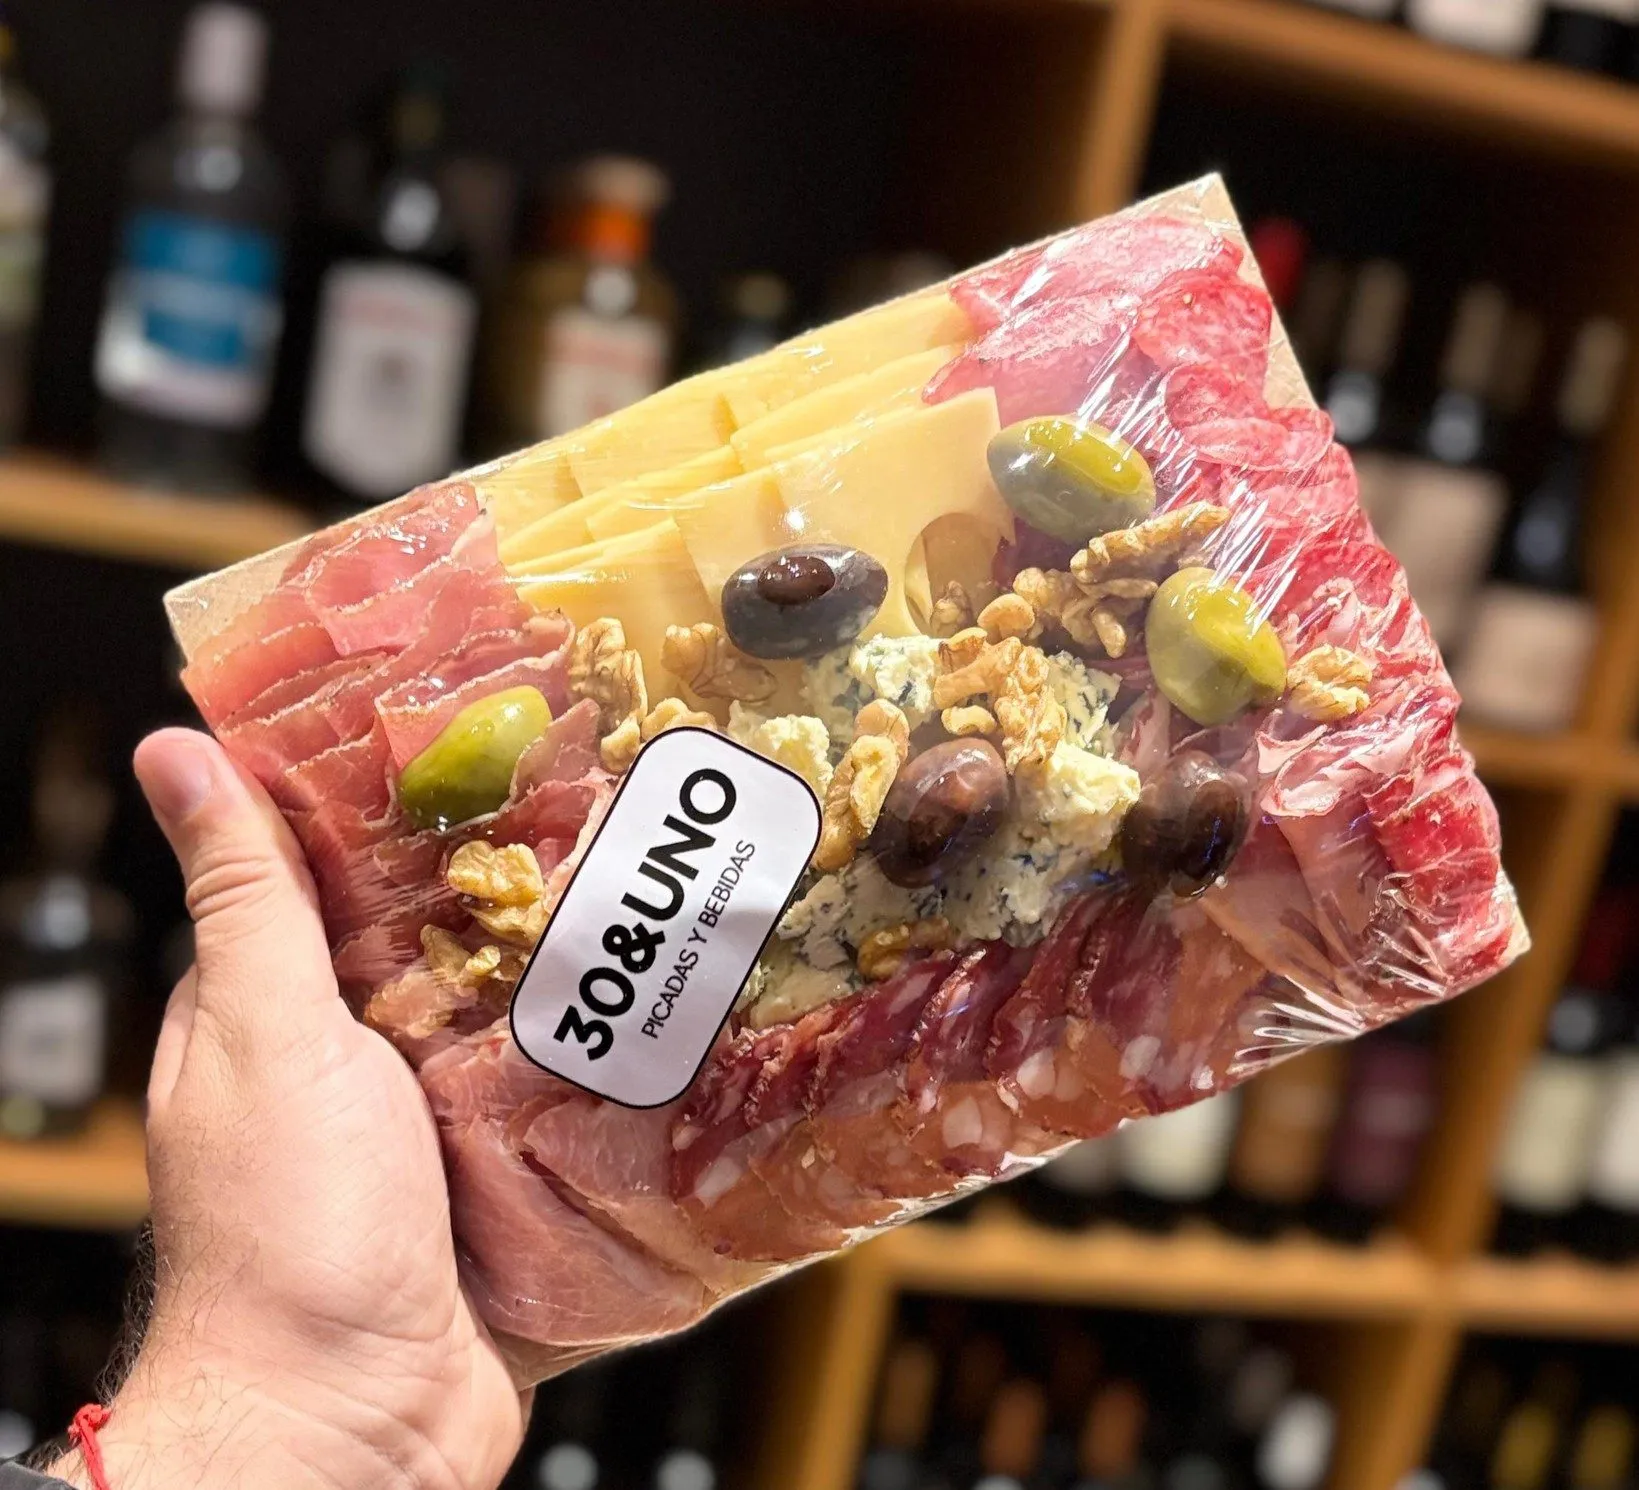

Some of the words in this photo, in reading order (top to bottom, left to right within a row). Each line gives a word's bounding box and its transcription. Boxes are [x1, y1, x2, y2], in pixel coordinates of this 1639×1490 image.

[553, 768, 737, 1060] 30&UNO
[641, 949, 699, 1039] PICADAS
[687, 927, 708, 945] Y
[698, 840, 756, 929] BEBIDAS
